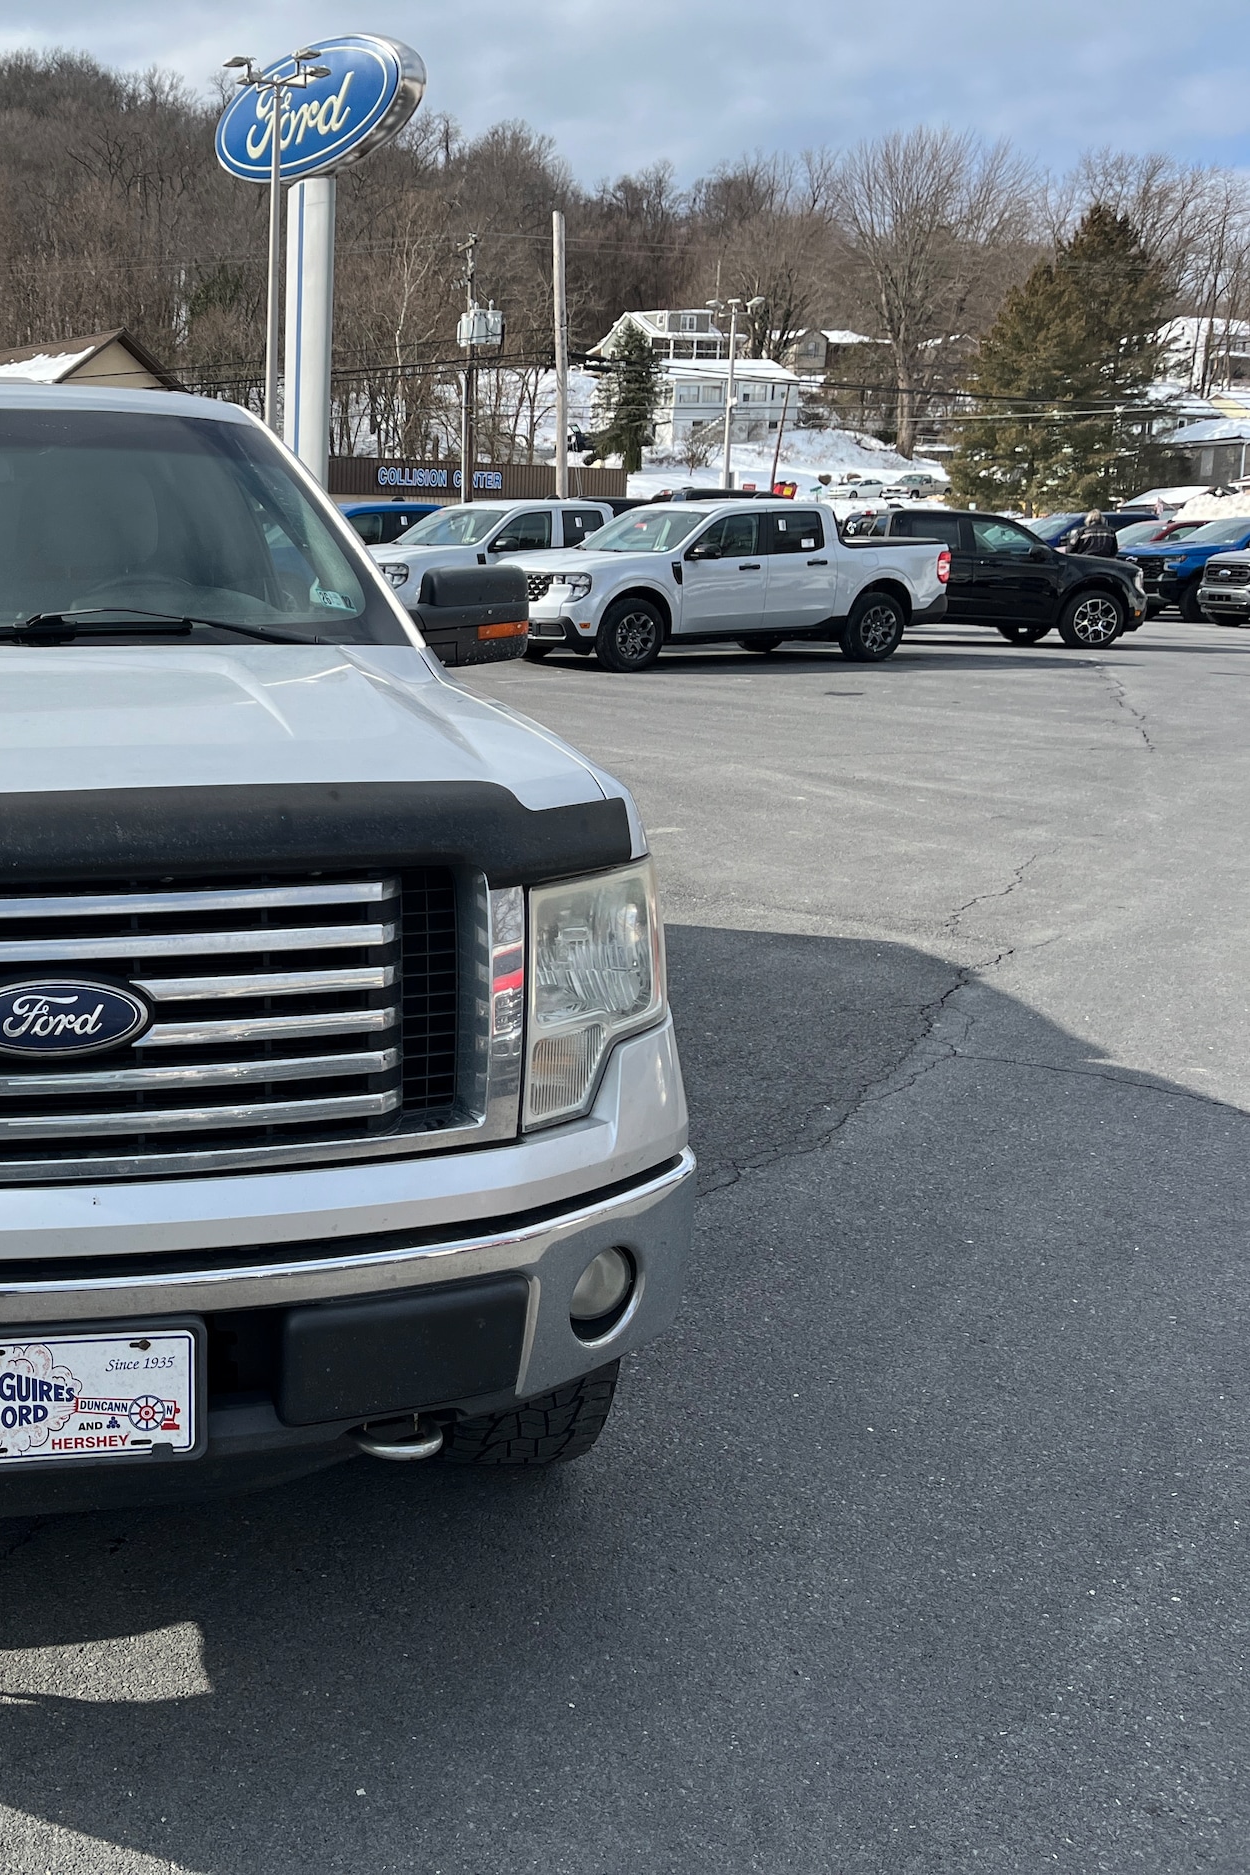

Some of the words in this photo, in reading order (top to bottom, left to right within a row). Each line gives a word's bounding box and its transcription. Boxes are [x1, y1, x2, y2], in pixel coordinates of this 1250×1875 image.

[246, 71, 354, 159] Ford
[378, 466, 448, 488] COLLISION
[453, 471, 502, 489] CNTER
[2, 995, 104, 1038] Ford
[105, 1358, 140, 1372] Since
[143, 1355, 176, 1369] 1935
[78, 1421, 103, 1431] AND
[51, 1433, 130, 1450] HERSHEY
